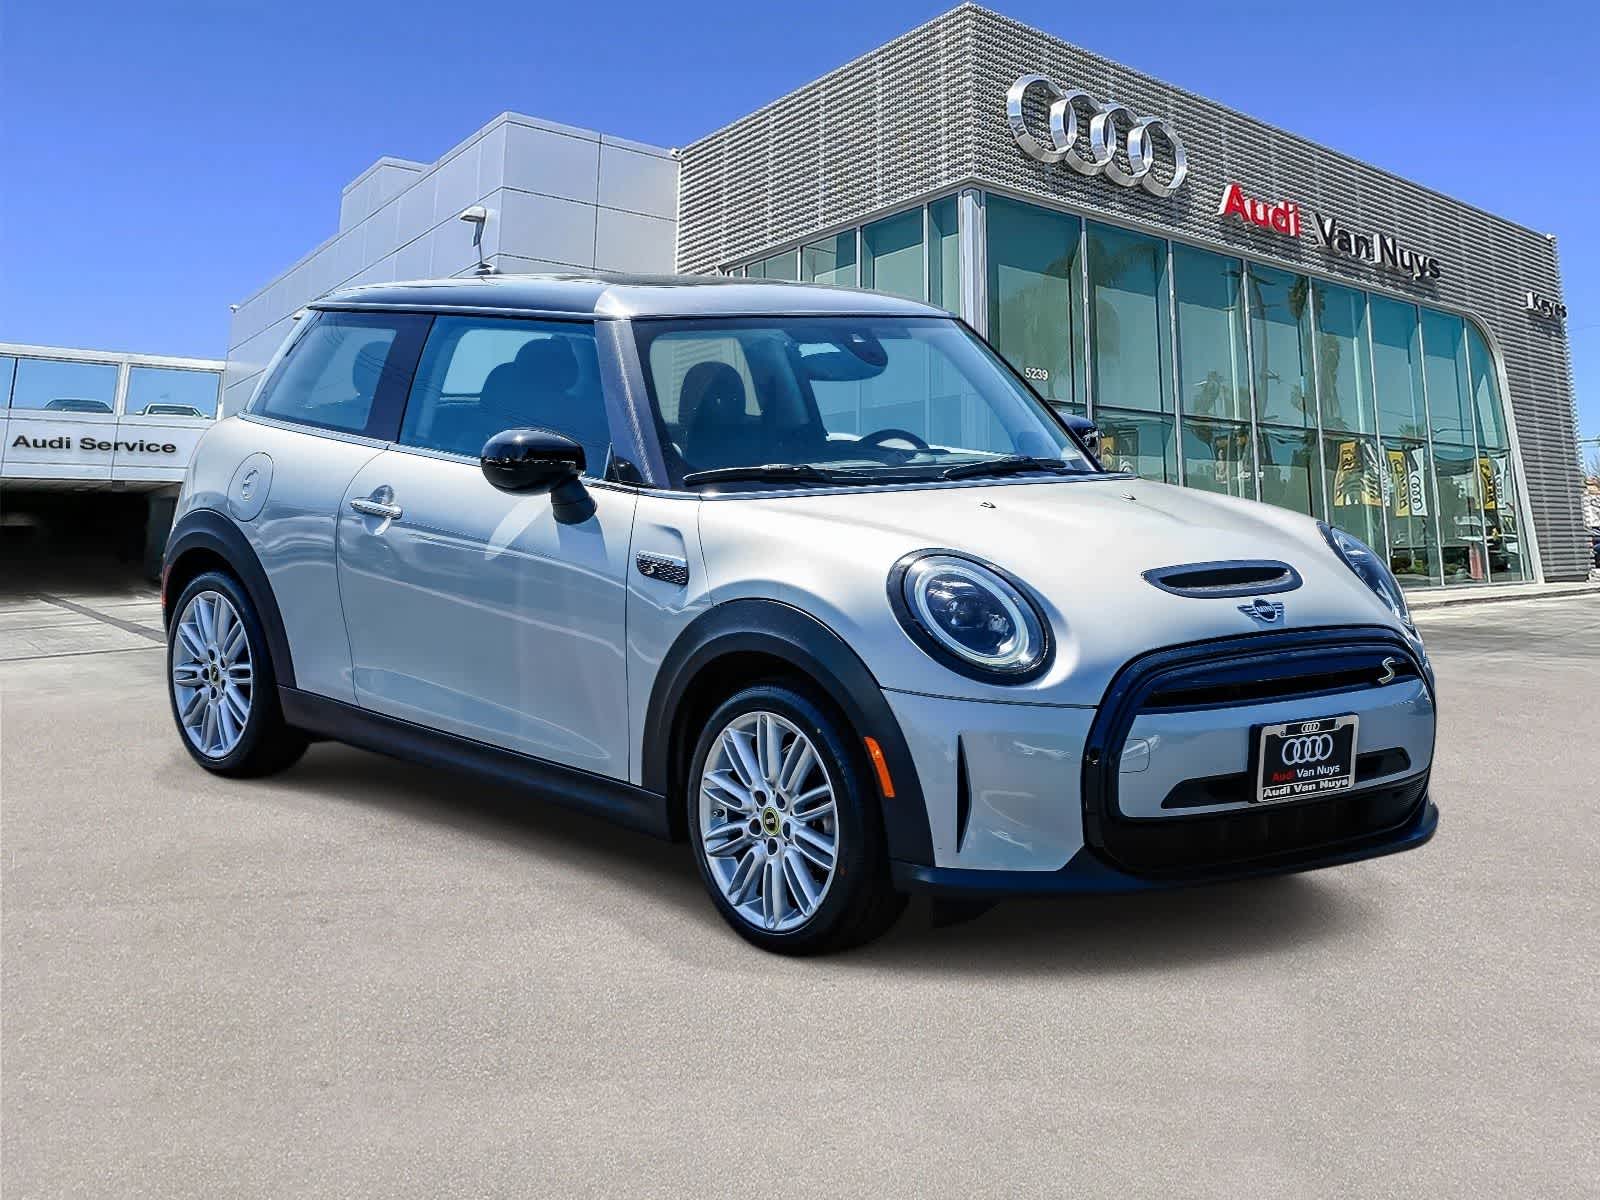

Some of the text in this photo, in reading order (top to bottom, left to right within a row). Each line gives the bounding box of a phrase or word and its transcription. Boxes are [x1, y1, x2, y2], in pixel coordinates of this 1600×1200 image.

[1217, 182, 1441, 281] Audi Van Nuys
[1025, 367, 1049, 381] 5239
[12, 435, 177, 454] Audi Service
[1377, 656, 1396, 685] S
[1296, 768, 1315, 778] Van
[1317, 764, 1341, 776] Nuys
[1263, 778, 1349, 798] Audi Van Nuys
